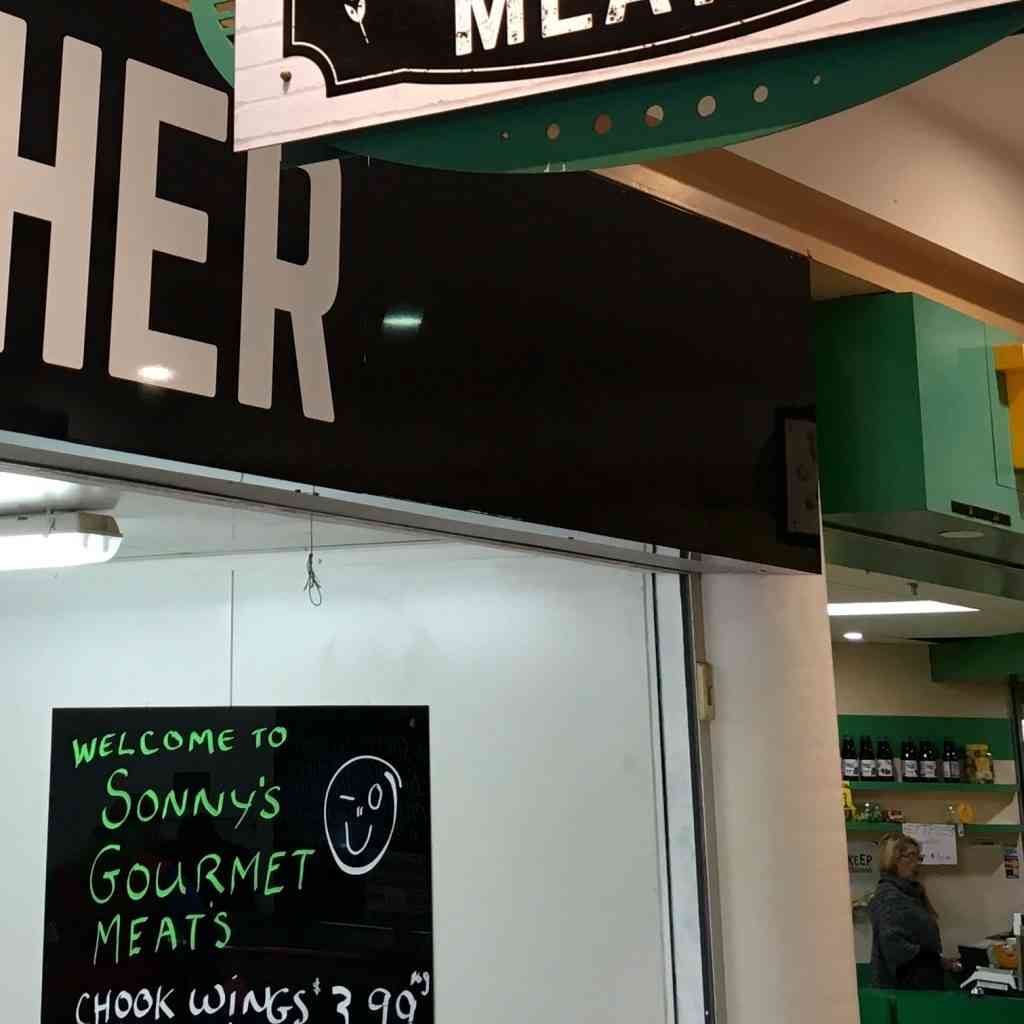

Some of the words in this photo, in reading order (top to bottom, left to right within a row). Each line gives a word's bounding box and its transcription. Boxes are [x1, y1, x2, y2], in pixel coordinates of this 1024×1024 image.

[71, 728, 235, 768] WELCOME
[251, 726, 288, 749] TO
[89, 843, 317, 905] GOURMET
[75, 985, 176, 1024] CHOOK
